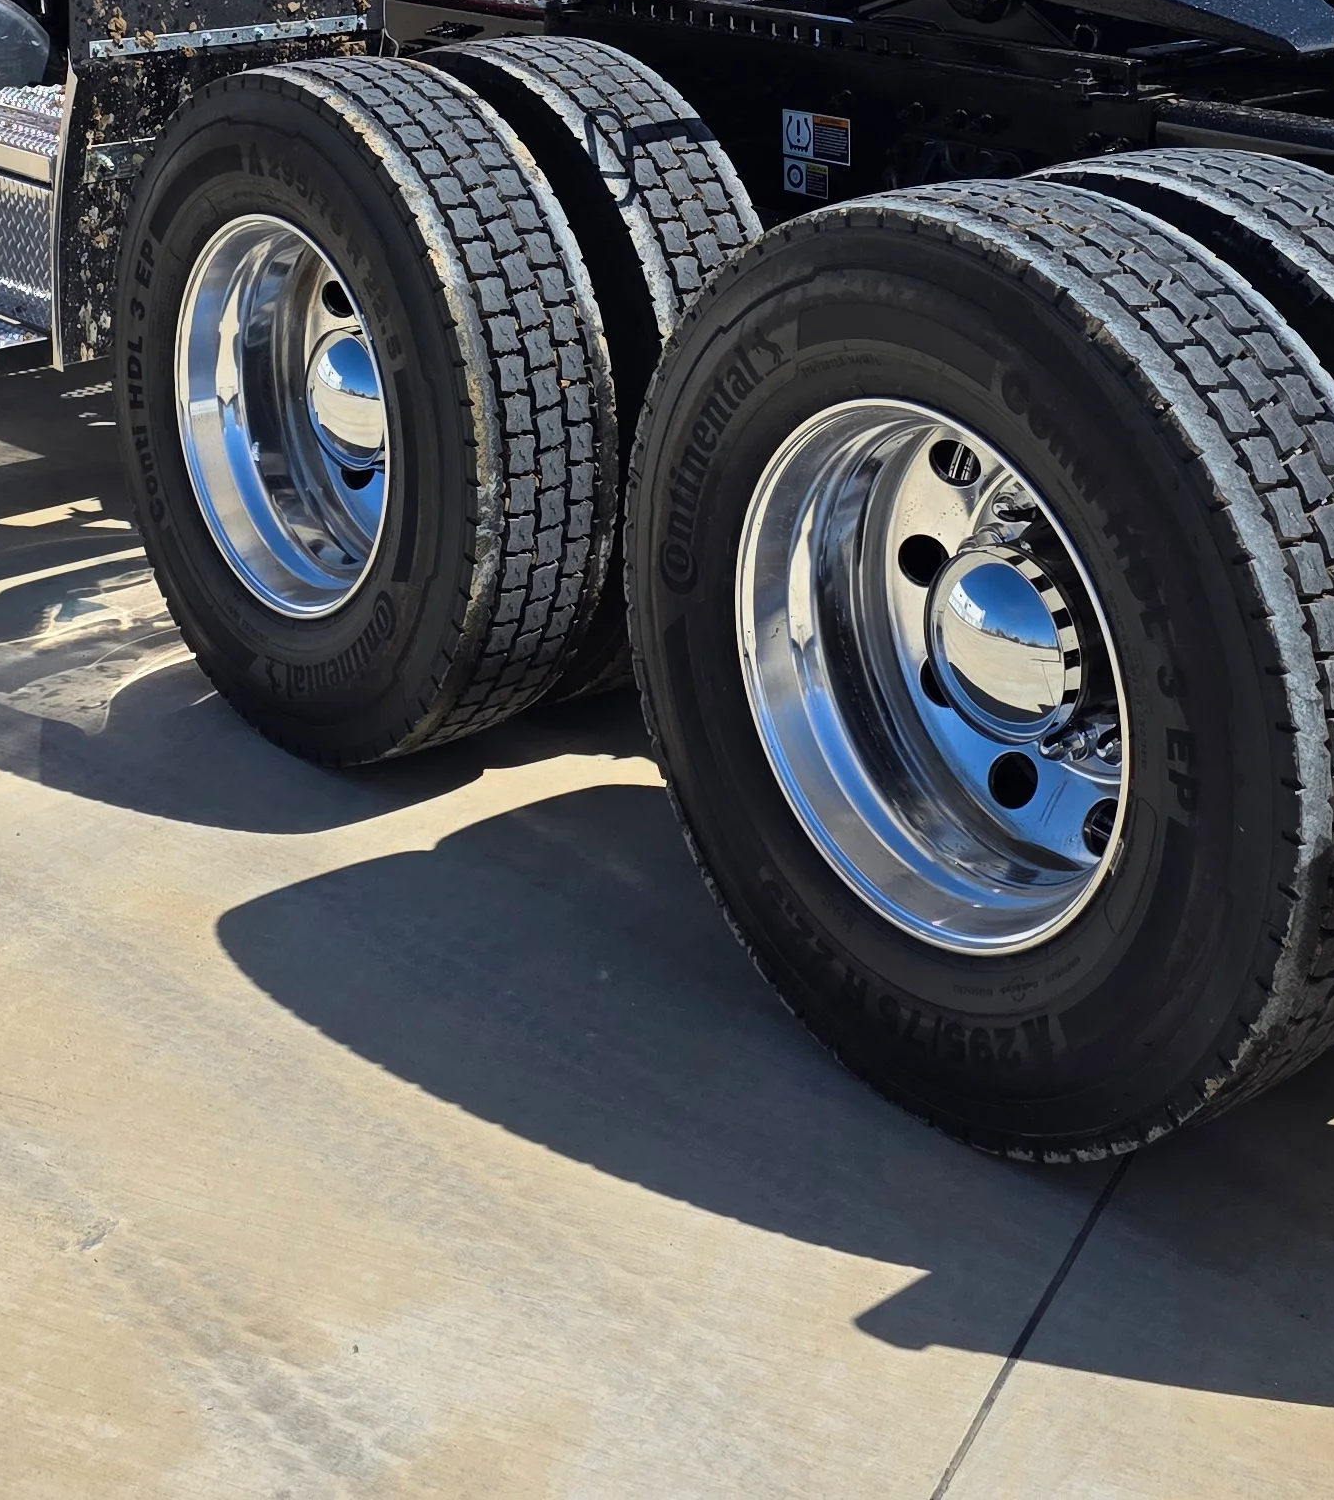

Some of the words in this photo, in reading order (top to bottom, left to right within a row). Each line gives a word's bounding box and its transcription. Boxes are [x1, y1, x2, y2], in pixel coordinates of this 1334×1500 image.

[134, 238, 156, 290] EP
[130, 297, 146, 321] 3
[127, 336, 145, 410] HDL
[132, 425, 165, 526] Conti
[659, 343, 764, 595] Continental
[286, 590, 397, 700] Continental
[1167, 727, 1200, 814] EP
